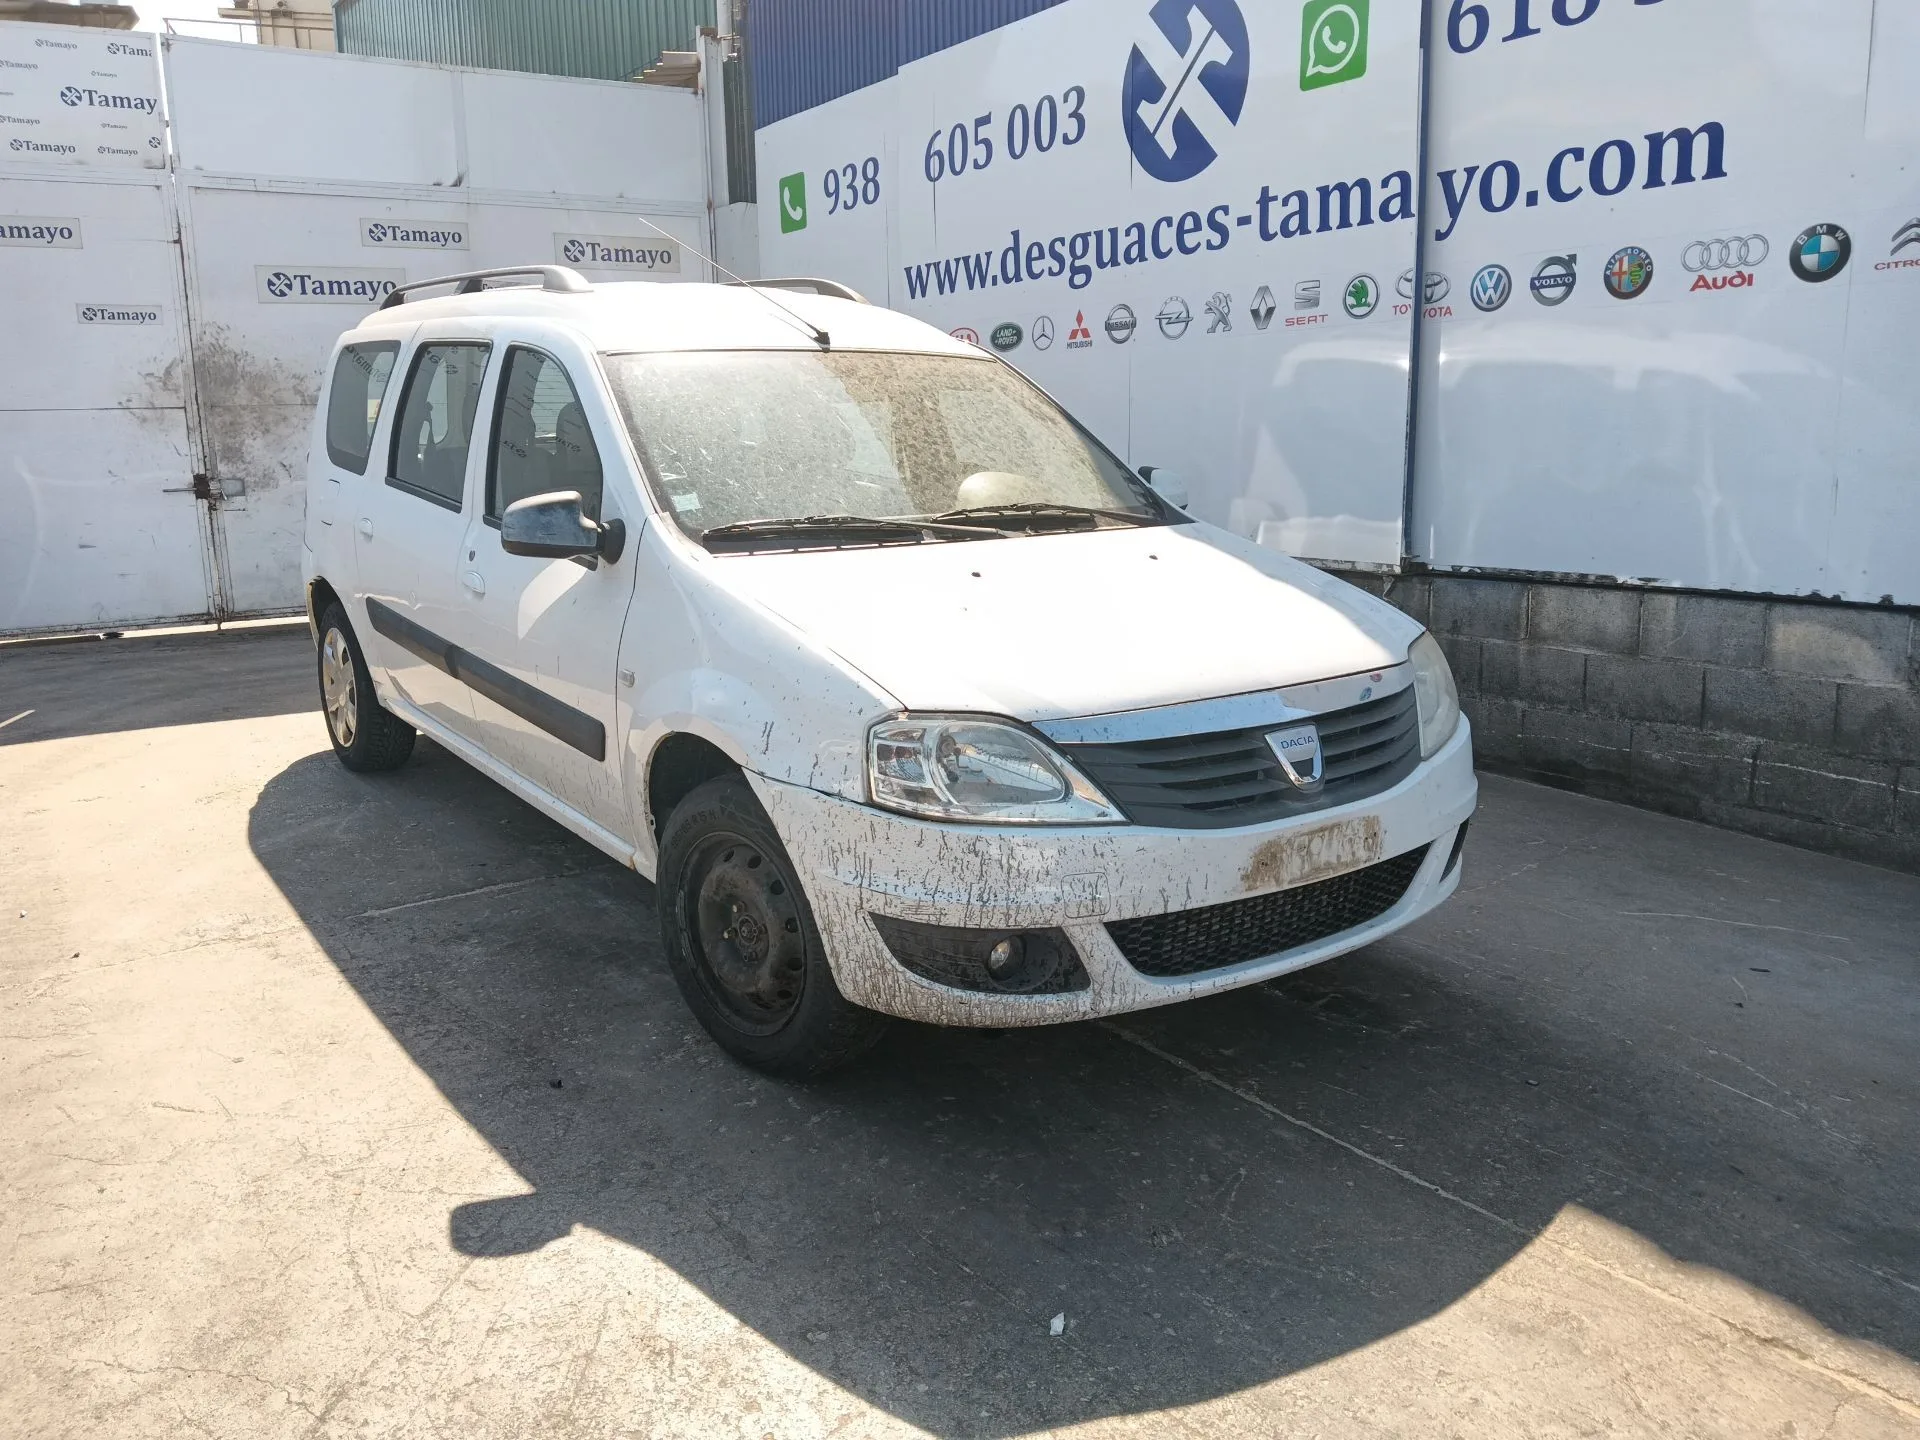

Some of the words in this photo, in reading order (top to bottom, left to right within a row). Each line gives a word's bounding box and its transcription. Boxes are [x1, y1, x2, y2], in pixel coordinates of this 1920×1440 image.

[6, 116, 41, 126] Tamayo
[23, 140, 77, 156] Tamayo
[106, 147, 139, 157] Tamayo
[824, 157, 880, 215] 938
[924, 111, 994, 183] 605
[1007, 85, 1087, 160] 003
[388, 225, 463, 247] Tamayo
[586, 242, 673, 269] Tamayo
[294, 275, 397, 301] Tamayo
[1533, 275, 1573, 287] VOLVO
[1689, 270, 1754, 292] Audi
[98, 309, 157, 324] Tamayo
[1285, 314, 1328, 327] SEAT
[1066, 340, 1093, 350] MITSUBISHI
[1281, 736, 1315, 749] DACIA
